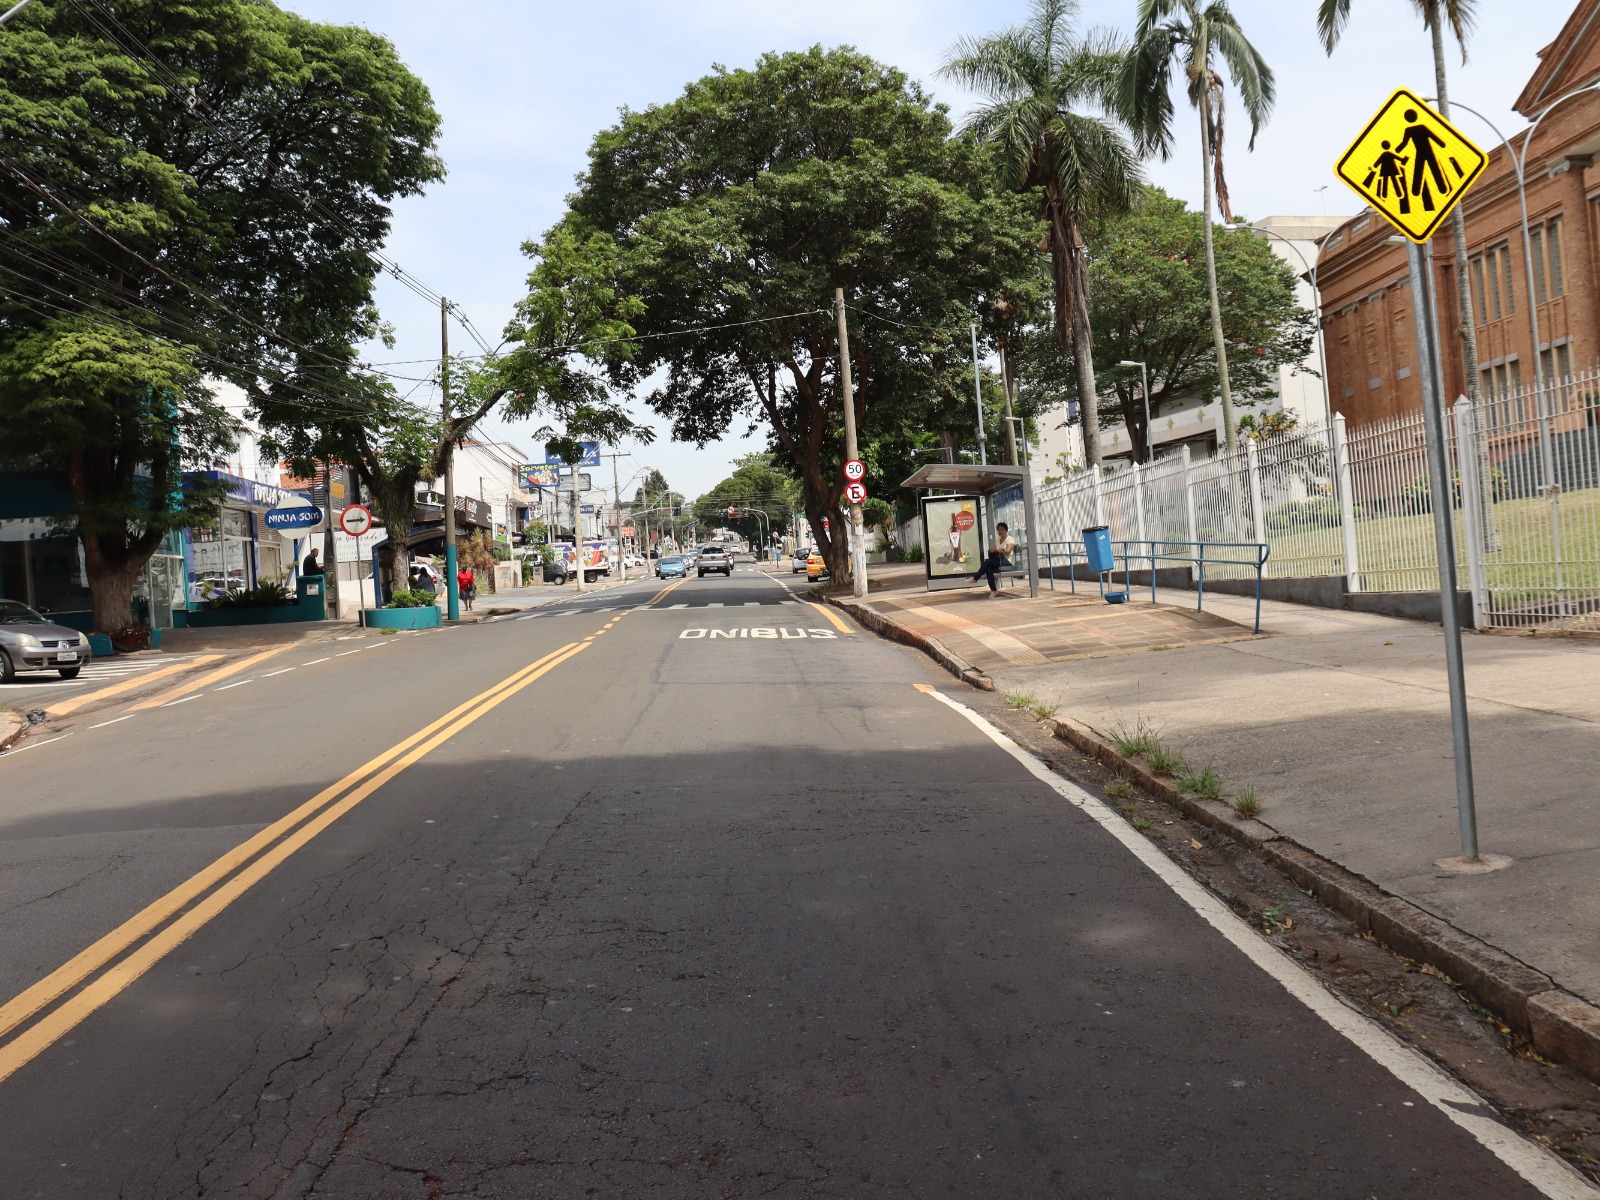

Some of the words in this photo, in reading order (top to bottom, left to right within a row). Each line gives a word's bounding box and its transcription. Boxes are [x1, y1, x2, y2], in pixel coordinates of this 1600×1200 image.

[519, 464, 558, 472] Sorvetes
[848, 464, 862, 474] 50
[254, 484, 278, 505] NINJA
[851, 486, 860, 499] E
[268, 513, 297, 524] NINJA
[299, 511, 319, 522] SOM
[679, 628, 838, 639] ONIBUS
